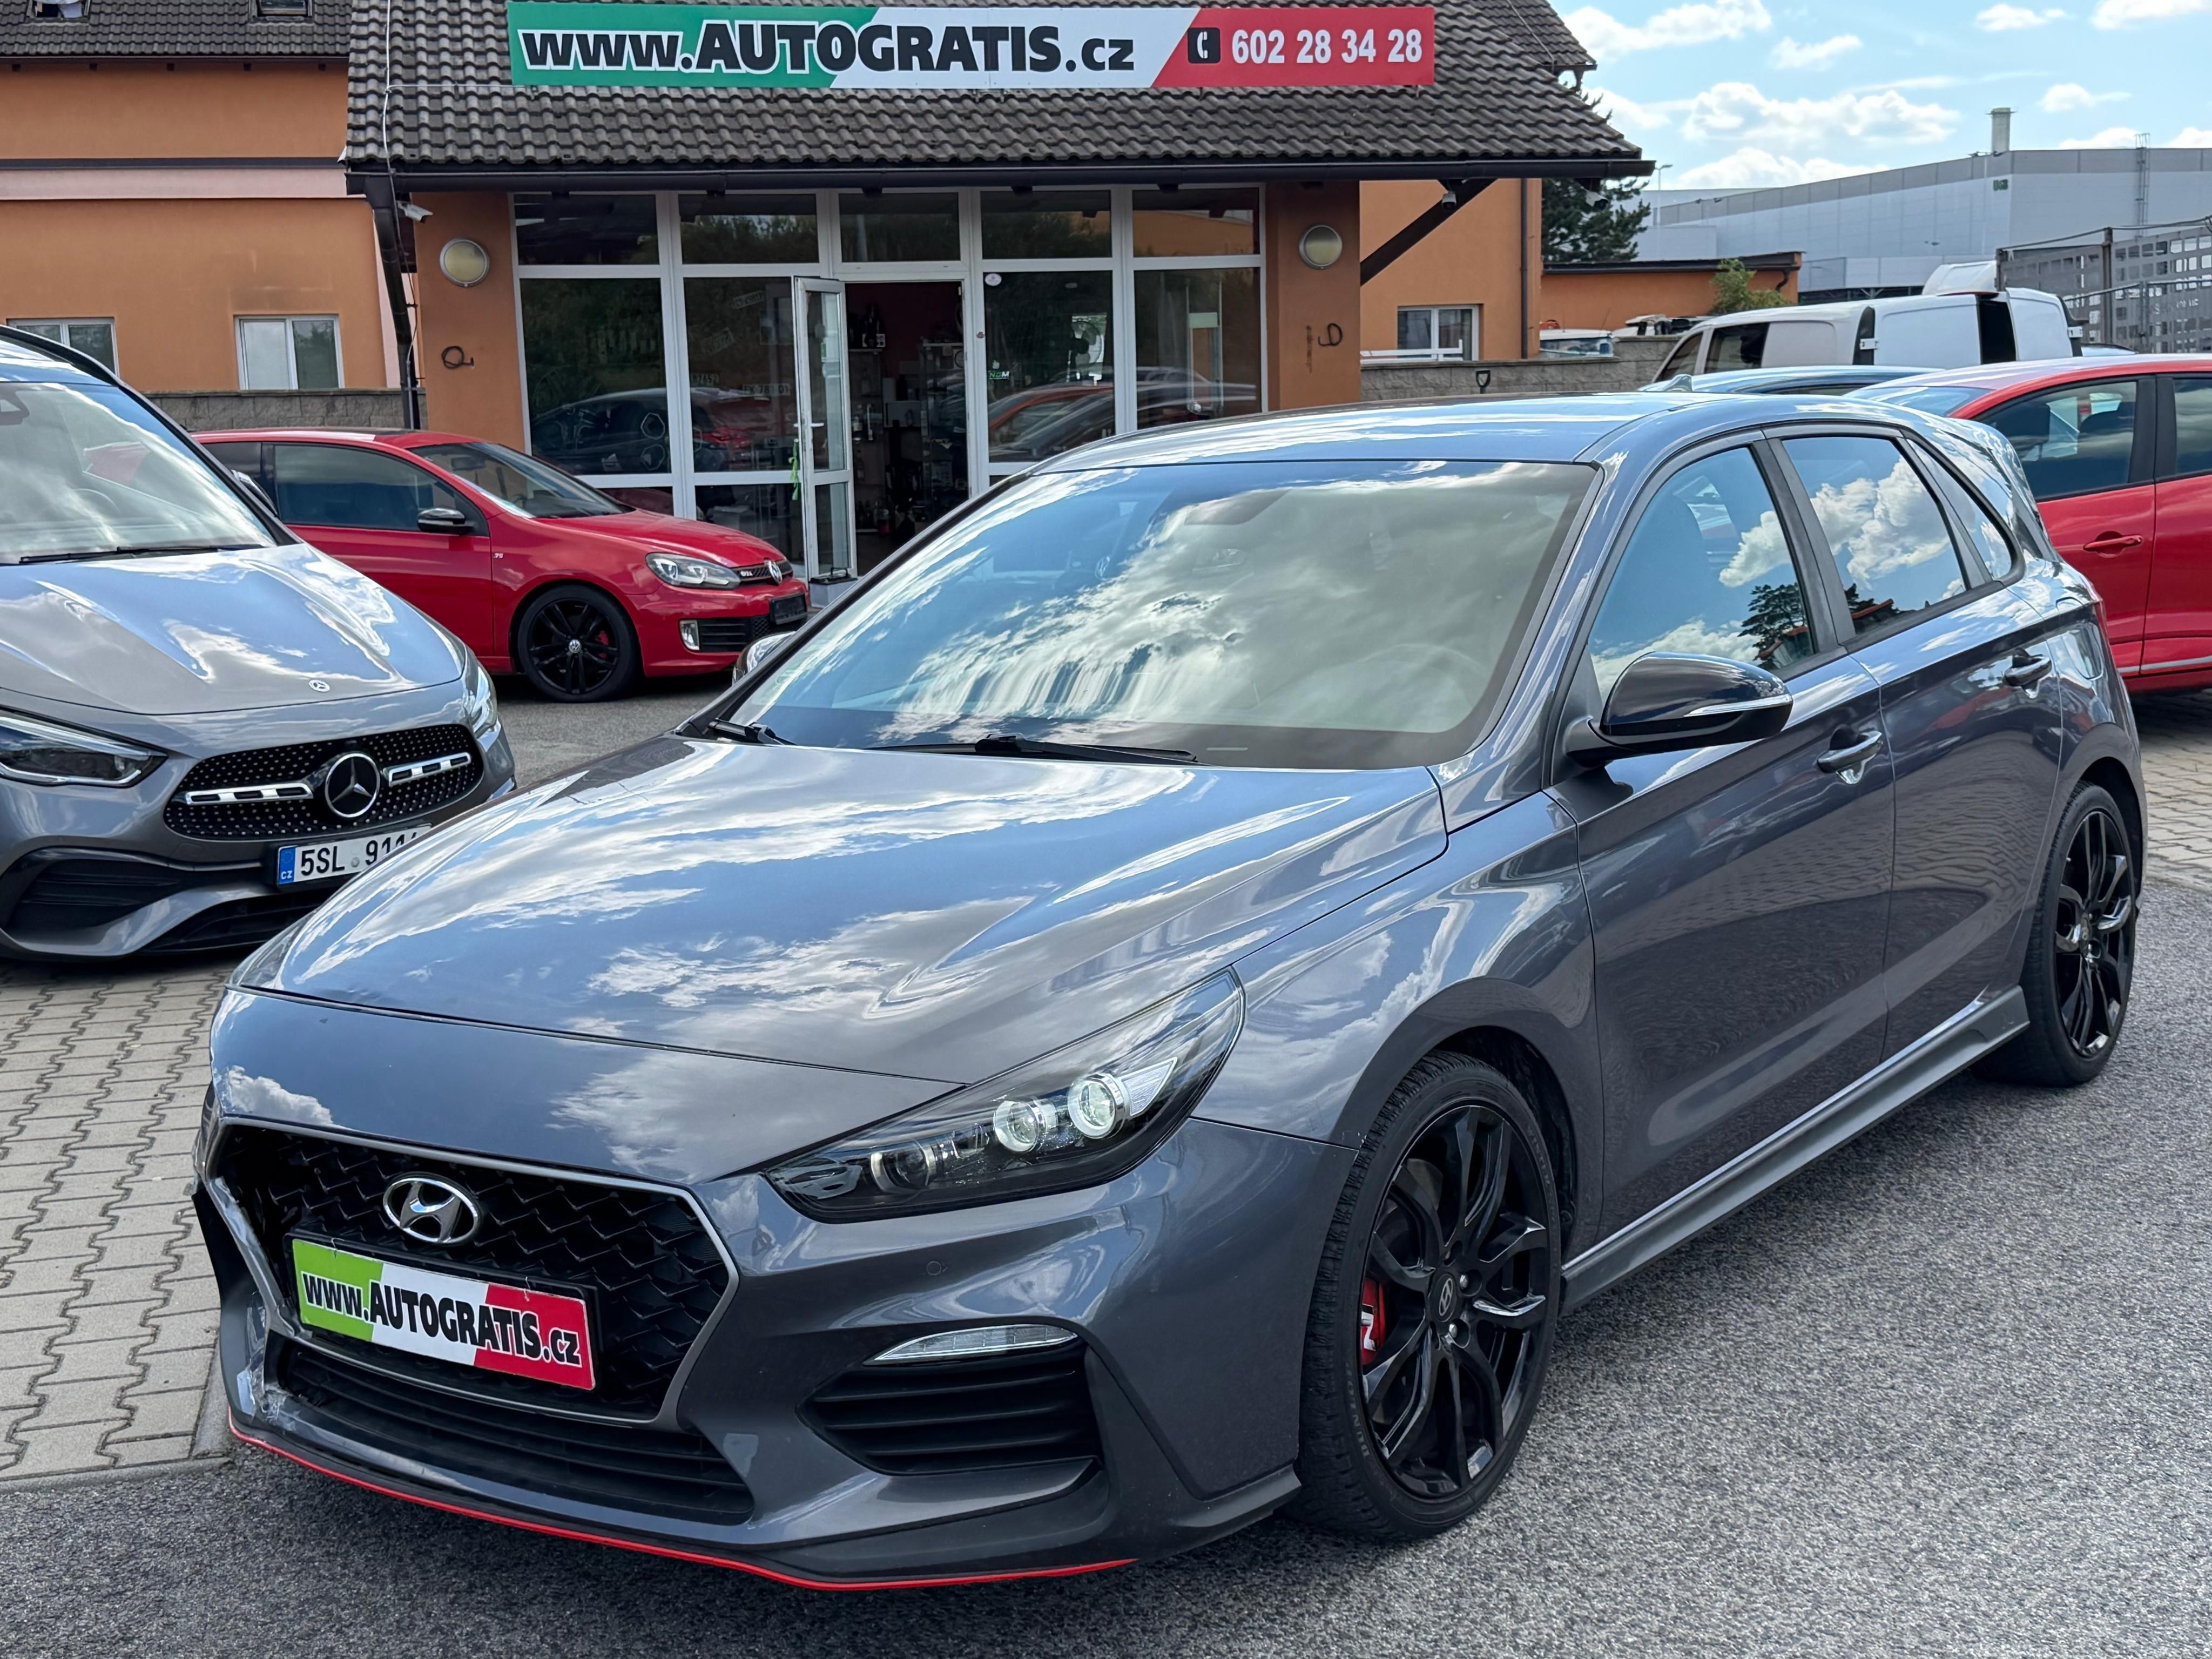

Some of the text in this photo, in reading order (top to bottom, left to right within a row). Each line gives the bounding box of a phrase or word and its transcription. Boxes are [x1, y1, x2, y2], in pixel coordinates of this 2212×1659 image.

[1231, 29, 1285, 64] 602
[1297, 29, 1332, 64] 28
[1341, 29, 1375, 63] 34
[1387, 29, 1423, 63] 28
[281, 870, 293, 879] CZ
[300, 846, 345, 876] 5SL
